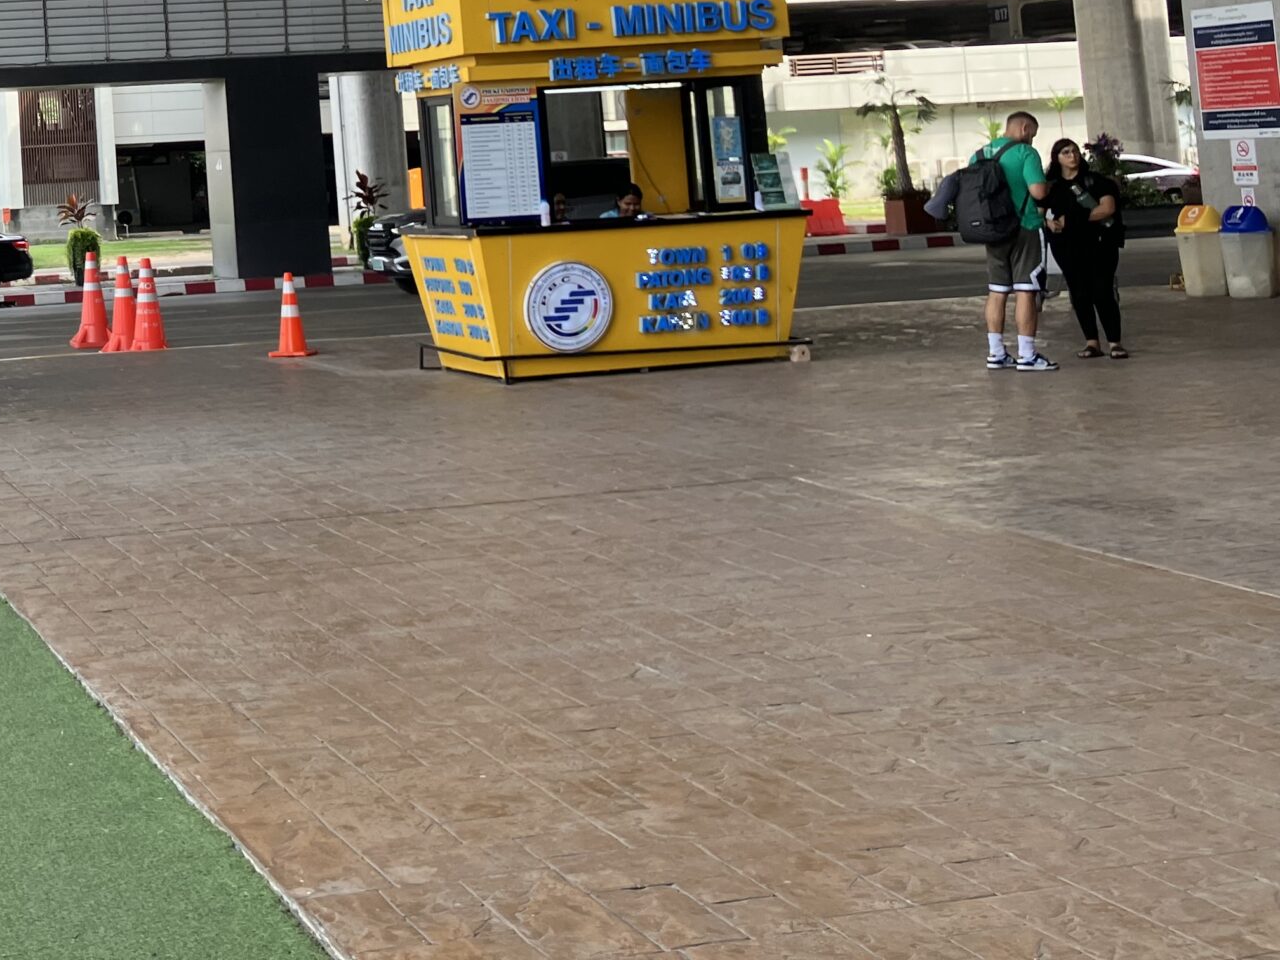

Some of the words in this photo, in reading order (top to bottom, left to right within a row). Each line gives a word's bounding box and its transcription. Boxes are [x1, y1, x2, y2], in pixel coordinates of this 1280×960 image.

[388, 13, 452, 56] MINIBUS
[485, 9, 577, 44] TAXI
[548, 52, 621, 81] 出租车
[639, 47, 712, 76] 面包车
[647, 246, 707, 265] TOWN
[635, 267, 712, 289] PATONG
